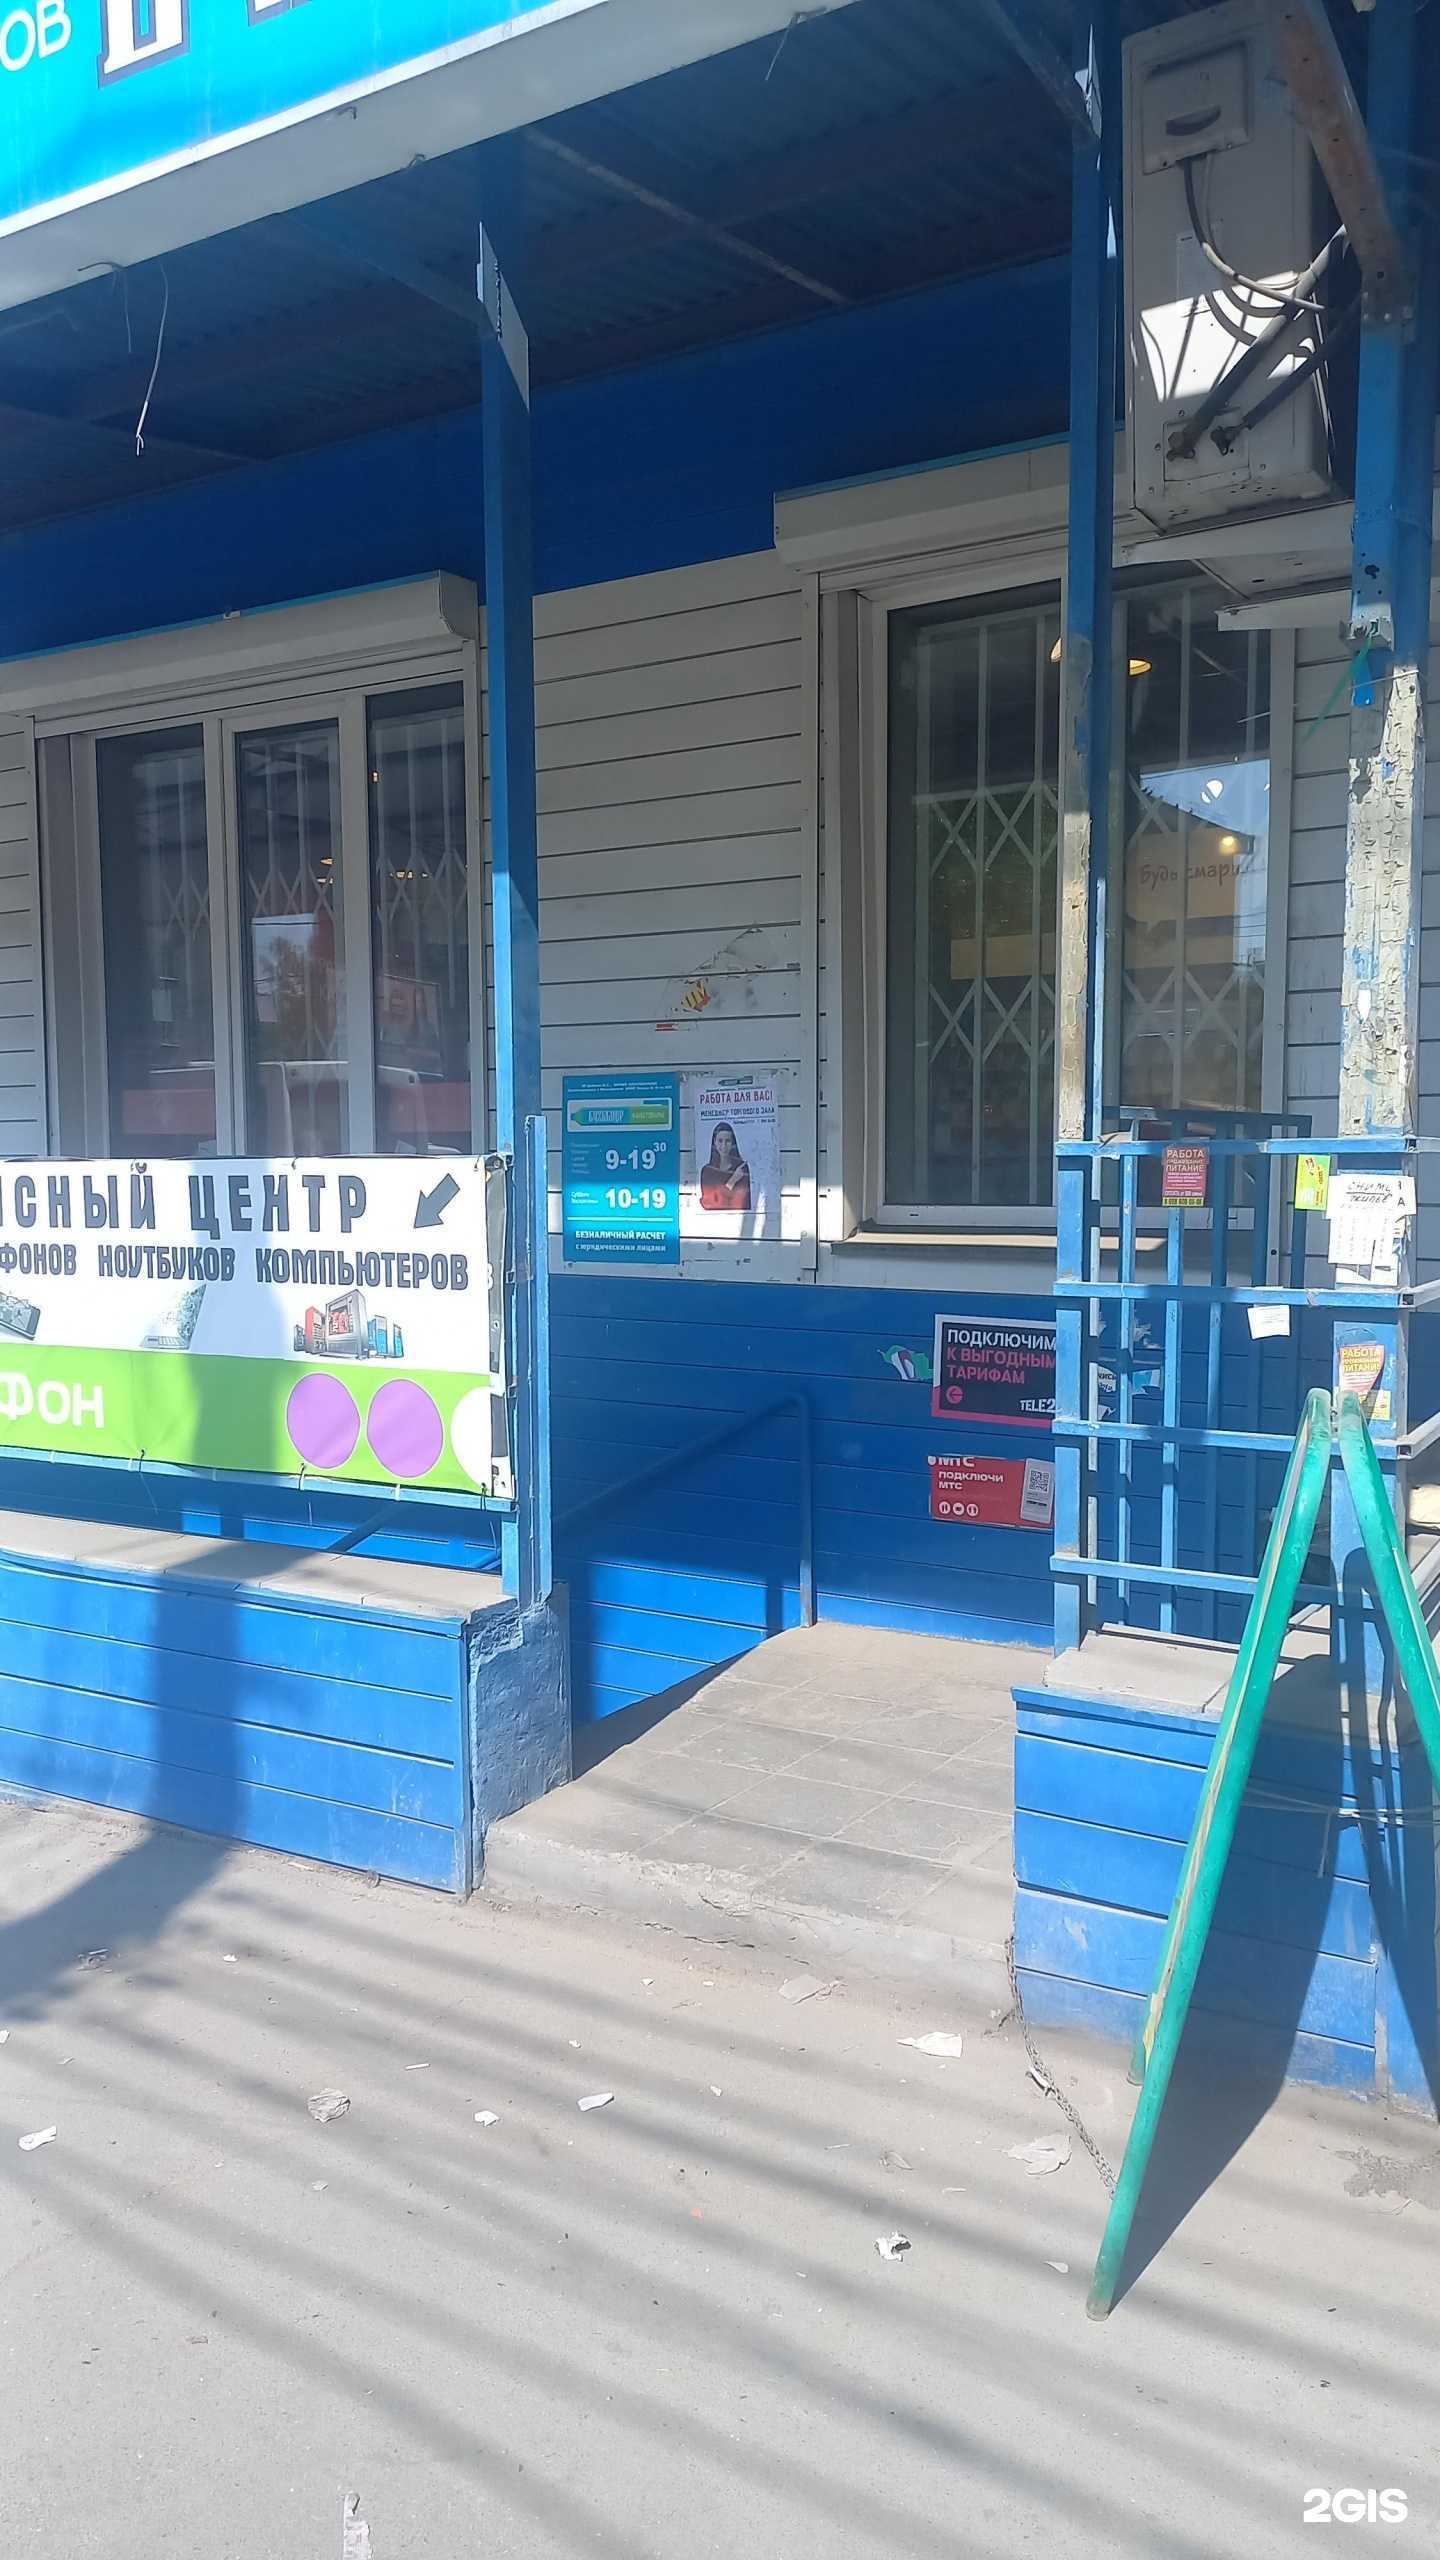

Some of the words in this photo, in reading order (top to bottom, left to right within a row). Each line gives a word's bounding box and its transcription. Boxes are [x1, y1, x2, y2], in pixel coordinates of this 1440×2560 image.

[700, 1092, 731, 1104] РАБОТА
[734, 1091, 751, 1103] ДЛЯ
[1167, 1149, 1205, 1158] РАБОТА
[1166, 1164, 1206, 1173] ПИТАНИЕ
[0, 1162, 156, 1229] СНЫЙ
[188, 1175, 367, 1240] ЦЕНТР
[605, 1188, 666, 1209] 10-19
[575, 1230, 635, 1240] БЕЗНАЛИЧНЫЙ
[636, 1231, 666, 1241] РАСЧЕТ
[0, 1243, 77, 1275] ФОНОВ
[98, 1245, 236, 1281] НОУТБУКОВ
[255, 1248, 469, 1290] КОМПЬЮТЕРОВ
[947, 1329, 1056, 1350] ПОДКЛЮЧИМ
[947, 1347, 957, 1361] К
[961, 1348, 1056, 1369] ВЫГОДНЫМ
[1343, 1347, 1381, 1358] РАБОТА
[946, 1364, 1025, 1384] ТАРИФАМ
[1019, 1398, 1056, 1413] TELE2
[938, 1481, 963, 1490] МТС
